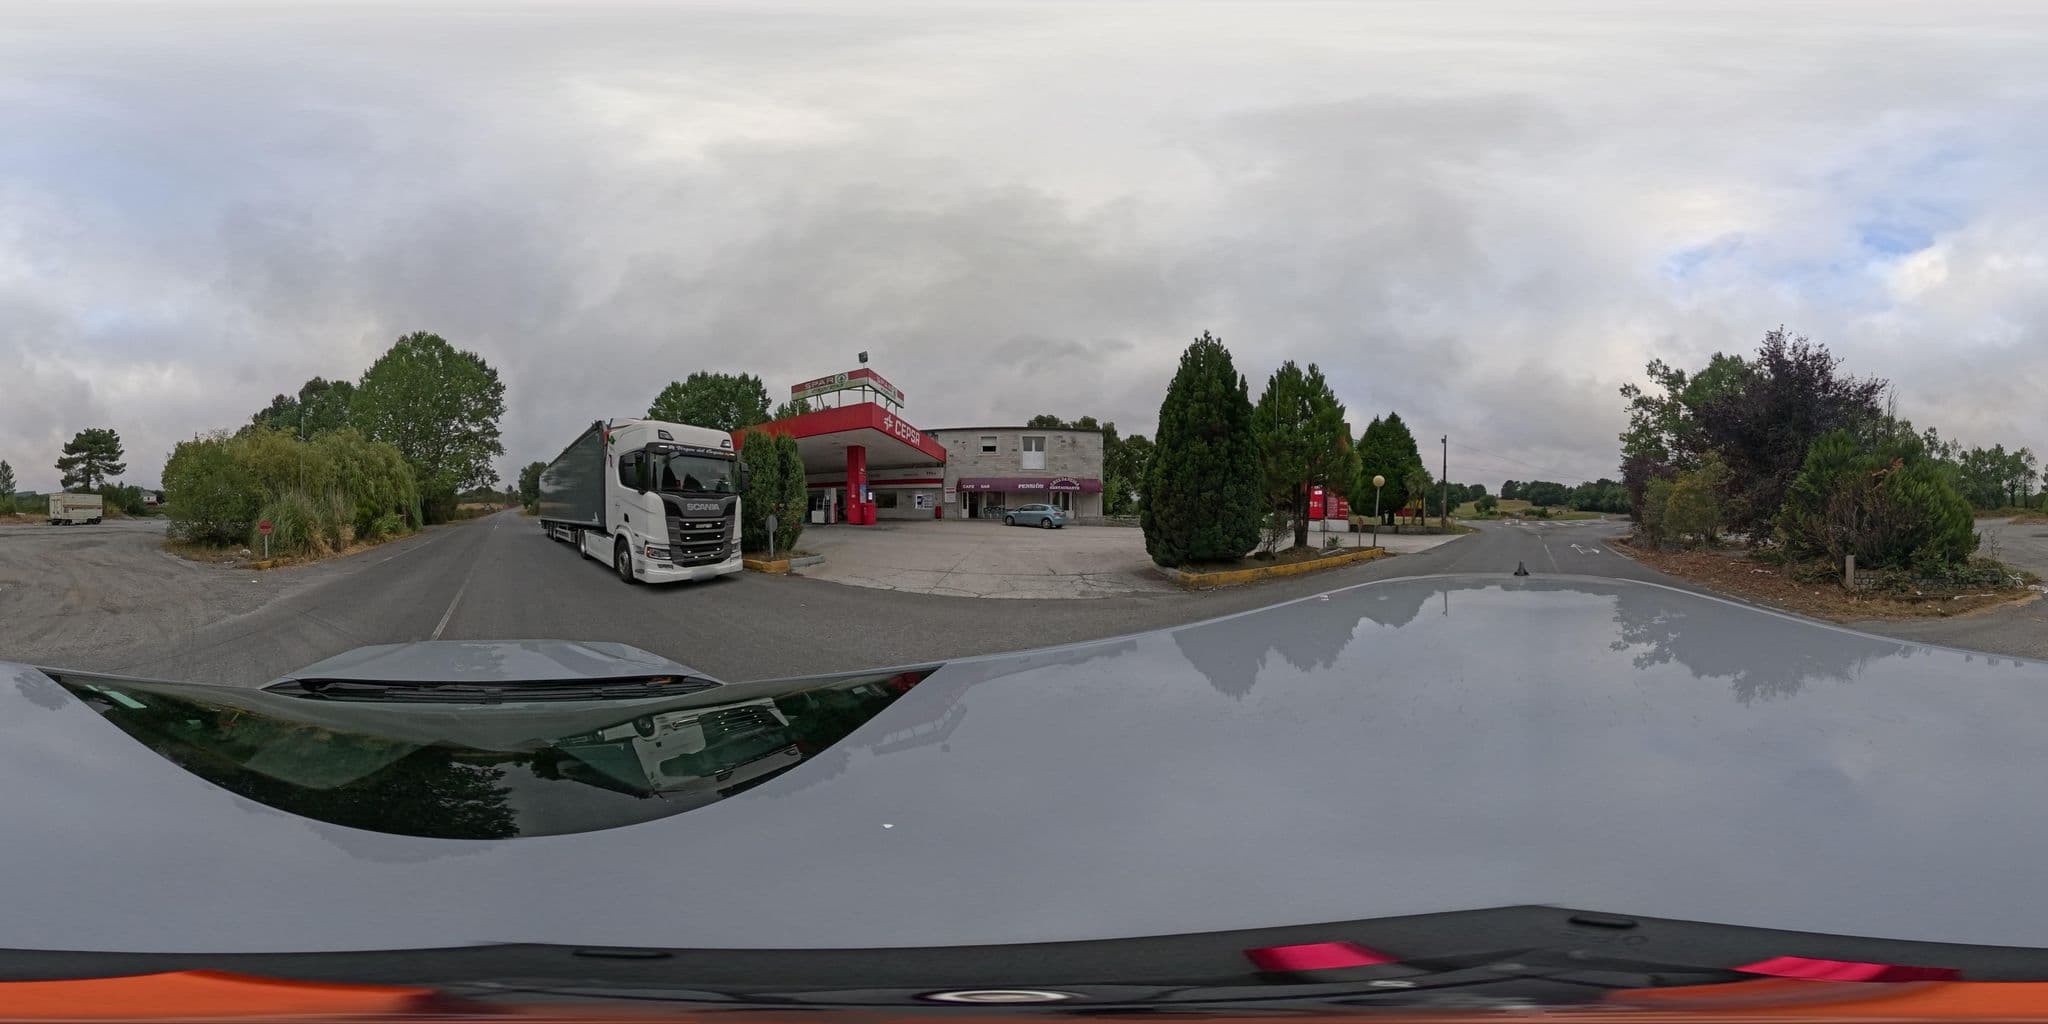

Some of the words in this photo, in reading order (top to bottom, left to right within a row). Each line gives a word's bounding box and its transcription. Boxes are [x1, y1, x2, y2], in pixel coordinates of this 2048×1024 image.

[804, 377, 834, 389] SPAR
[895, 420, 920, 446] CEPSA
[686, 503, 720, 511] SCANIA
